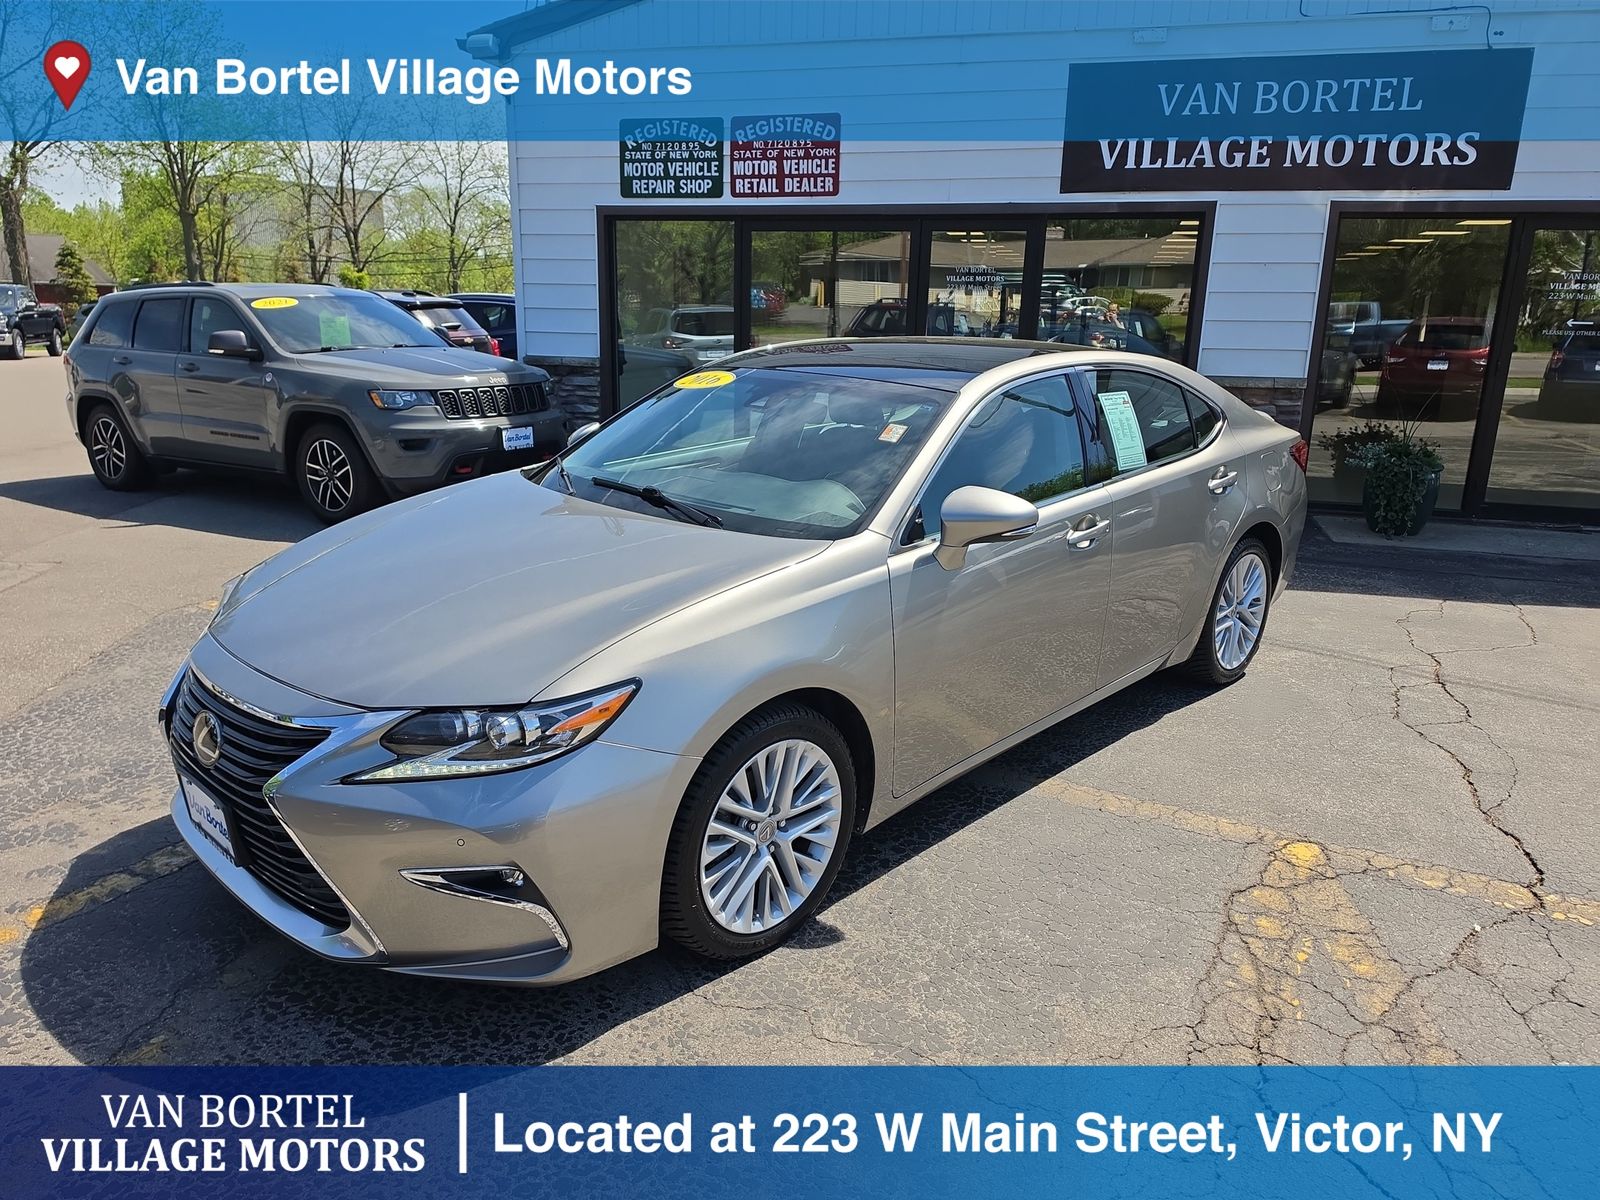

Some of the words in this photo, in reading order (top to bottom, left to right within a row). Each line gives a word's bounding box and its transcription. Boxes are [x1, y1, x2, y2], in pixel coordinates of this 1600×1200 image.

[1158, 82, 1241, 116] VAN
[1252, 76, 1423, 114] BORTEL
[624, 119, 717, 149] REGISTERED
[735, 117, 836, 145] REGISTERED
[656, 142, 700, 150] 7120895
[767, 139, 812, 148] 7120895
[625, 151, 652, 159] STATE
[654, 151, 667, 159] OF
[669, 151, 689, 159] NEW
[693, 150, 717, 159] YORK
[733, 150, 763, 159] STATE
[766, 149, 780, 158] OF
[783, 149, 805, 158] NEW
[808, 148, 836, 157] YORK
[1099, 135, 1273, 170] VILLAGE
[1283, 131, 1480, 168] MOTORS
[624, 162, 664, 177] MOTOR
[667, 161, 719, 177] VEHICLE
[733, 160, 777, 176] MOTOR
[782, 159, 836, 175] VEHICLE
[632, 179, 675, 194] REPAIR
[679, 179, 713, 194] SHOP
[735, 178, 779, 194] RETAIL
[784, 177, 834, 193] DEALER
[1563, 272, 1581, 280] VAN
[1550, 282, 1587, 290] VILLAGE
[1548, 292, 1564, 300] 223
[1565, 292, 1576, 300] W
[1576, 292, 1596, 300] Main
[488, 376, 507, 384] Jeep
